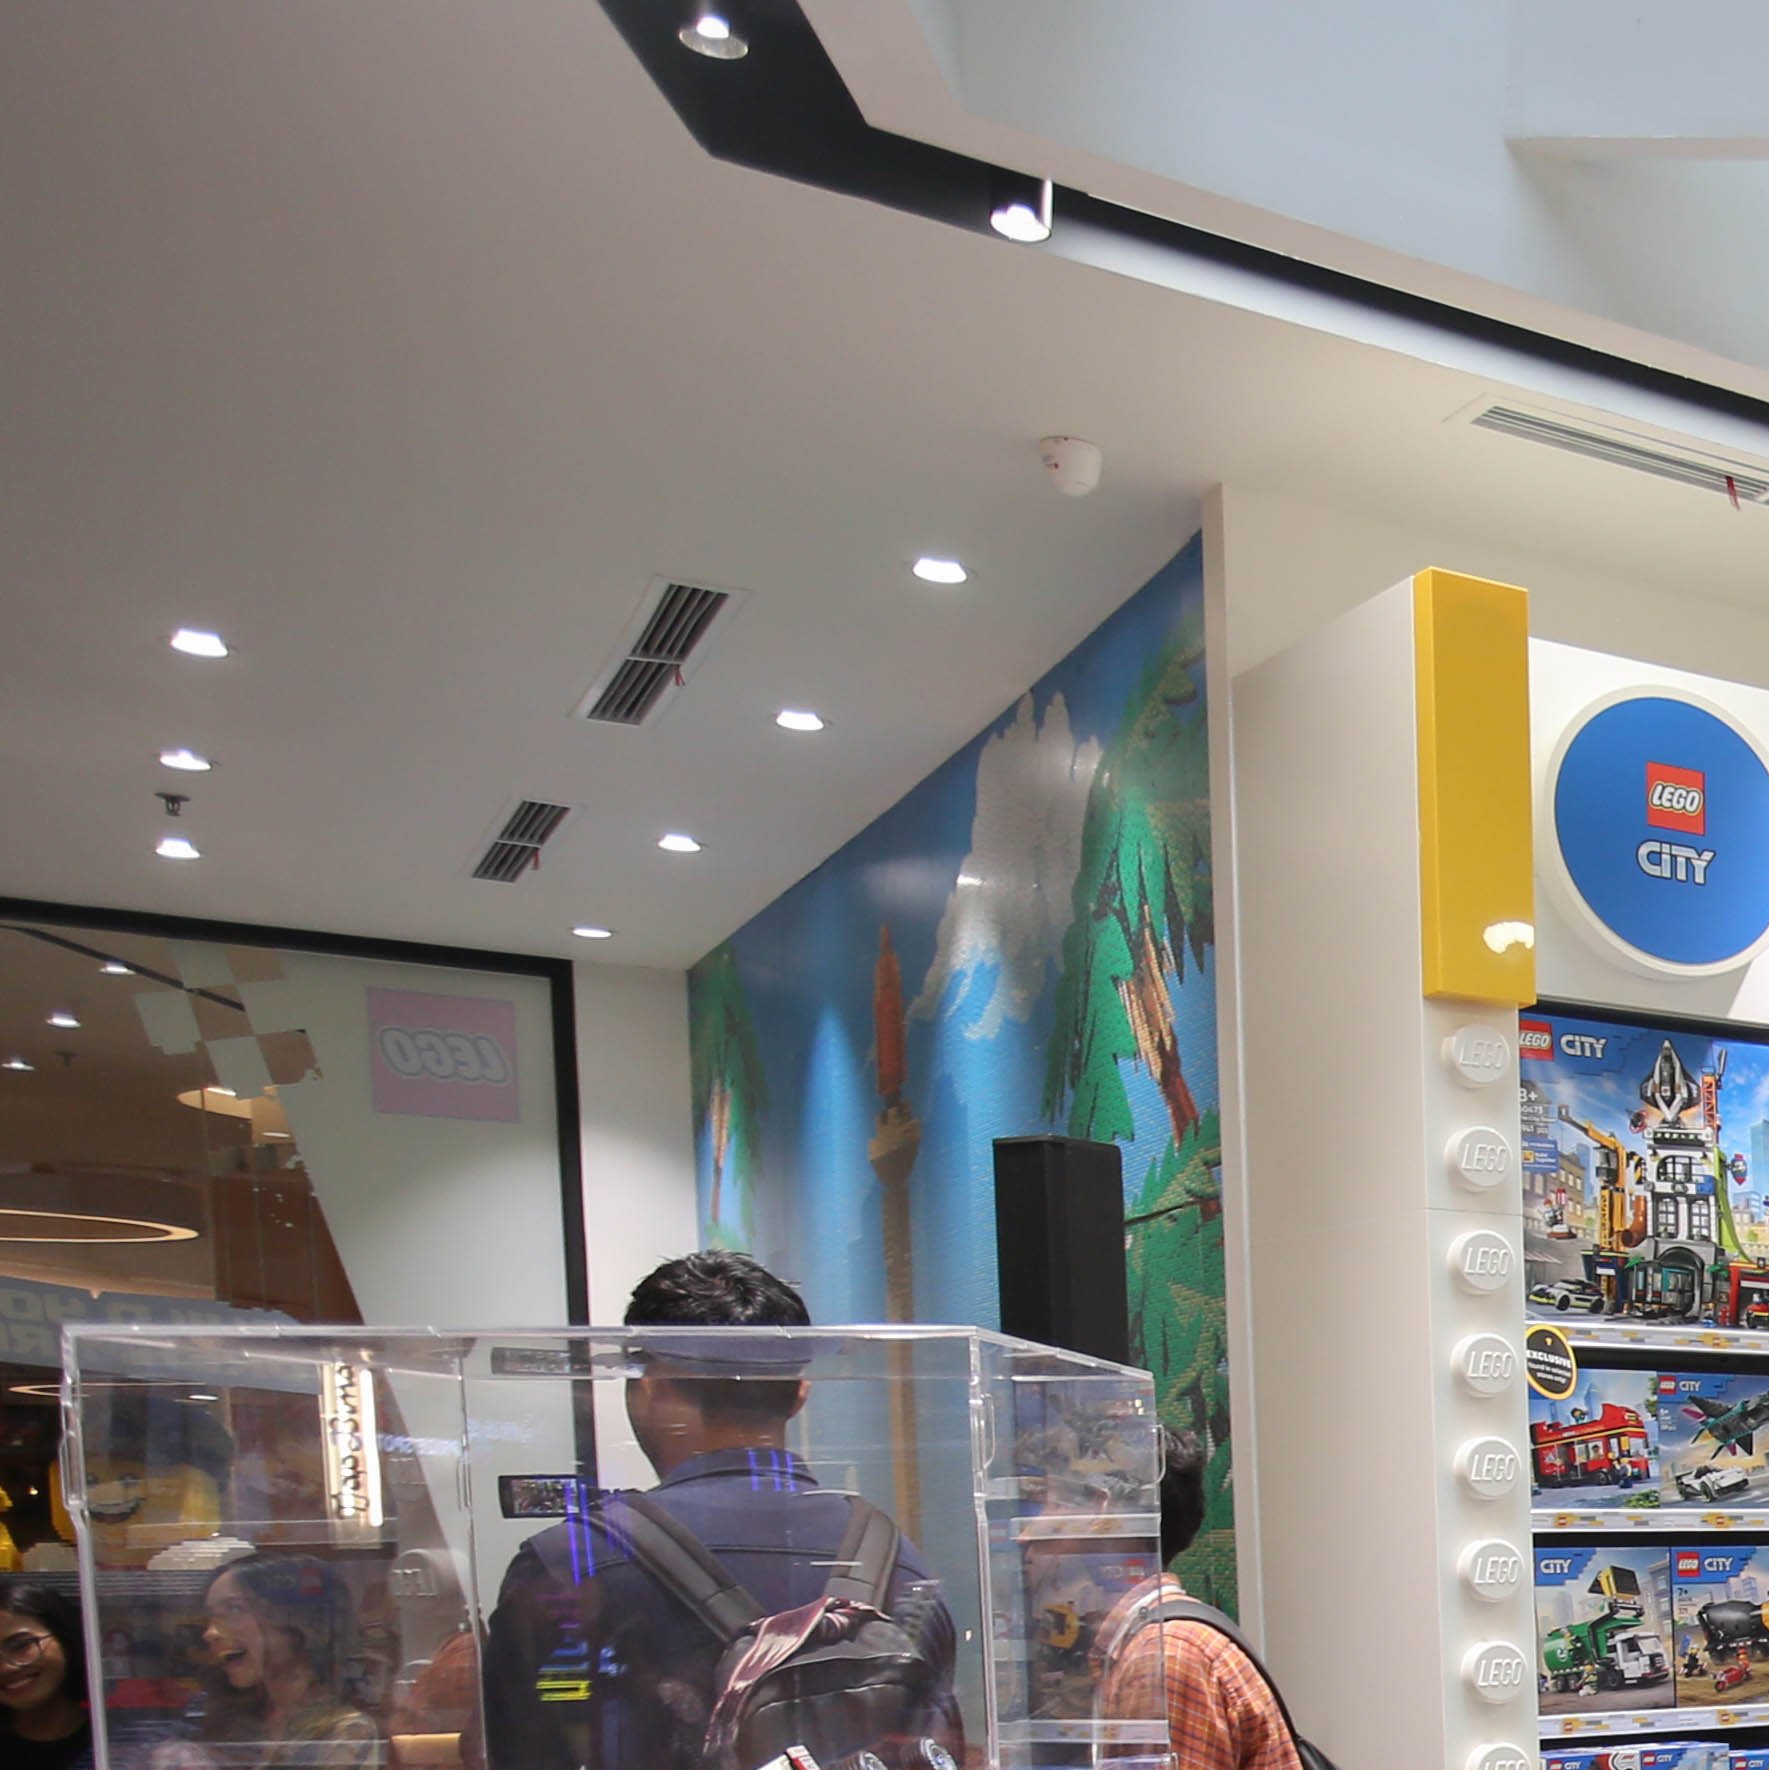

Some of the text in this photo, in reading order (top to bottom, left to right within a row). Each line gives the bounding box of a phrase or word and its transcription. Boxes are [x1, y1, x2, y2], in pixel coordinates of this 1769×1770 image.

[1649, 785, 1702, 816] LEGO
[1636, 839, 1716, 886] CITY
[1519, 1031, 1607, 1059] LEGO CITY
[1461, 1143, 1506, 1173] LEGO
[1464, 1246, 1511, 1276] LEGO
[1467, 1353, 1513, 1379] LEGO
[1680, 1380, 1702, 1391] CITY
[1470, 1455, 1515, 1482] LEGO
[1473, 1557, 1520, 1584] LEGO
[1540, 1558, 1572, 1574] CITY
[1678, 1556, 1734, 1573] LEGO CITY
[1477, 1659, 1522, 1687] LEGO
[1564, 1762, 1581, 1770] CITY
